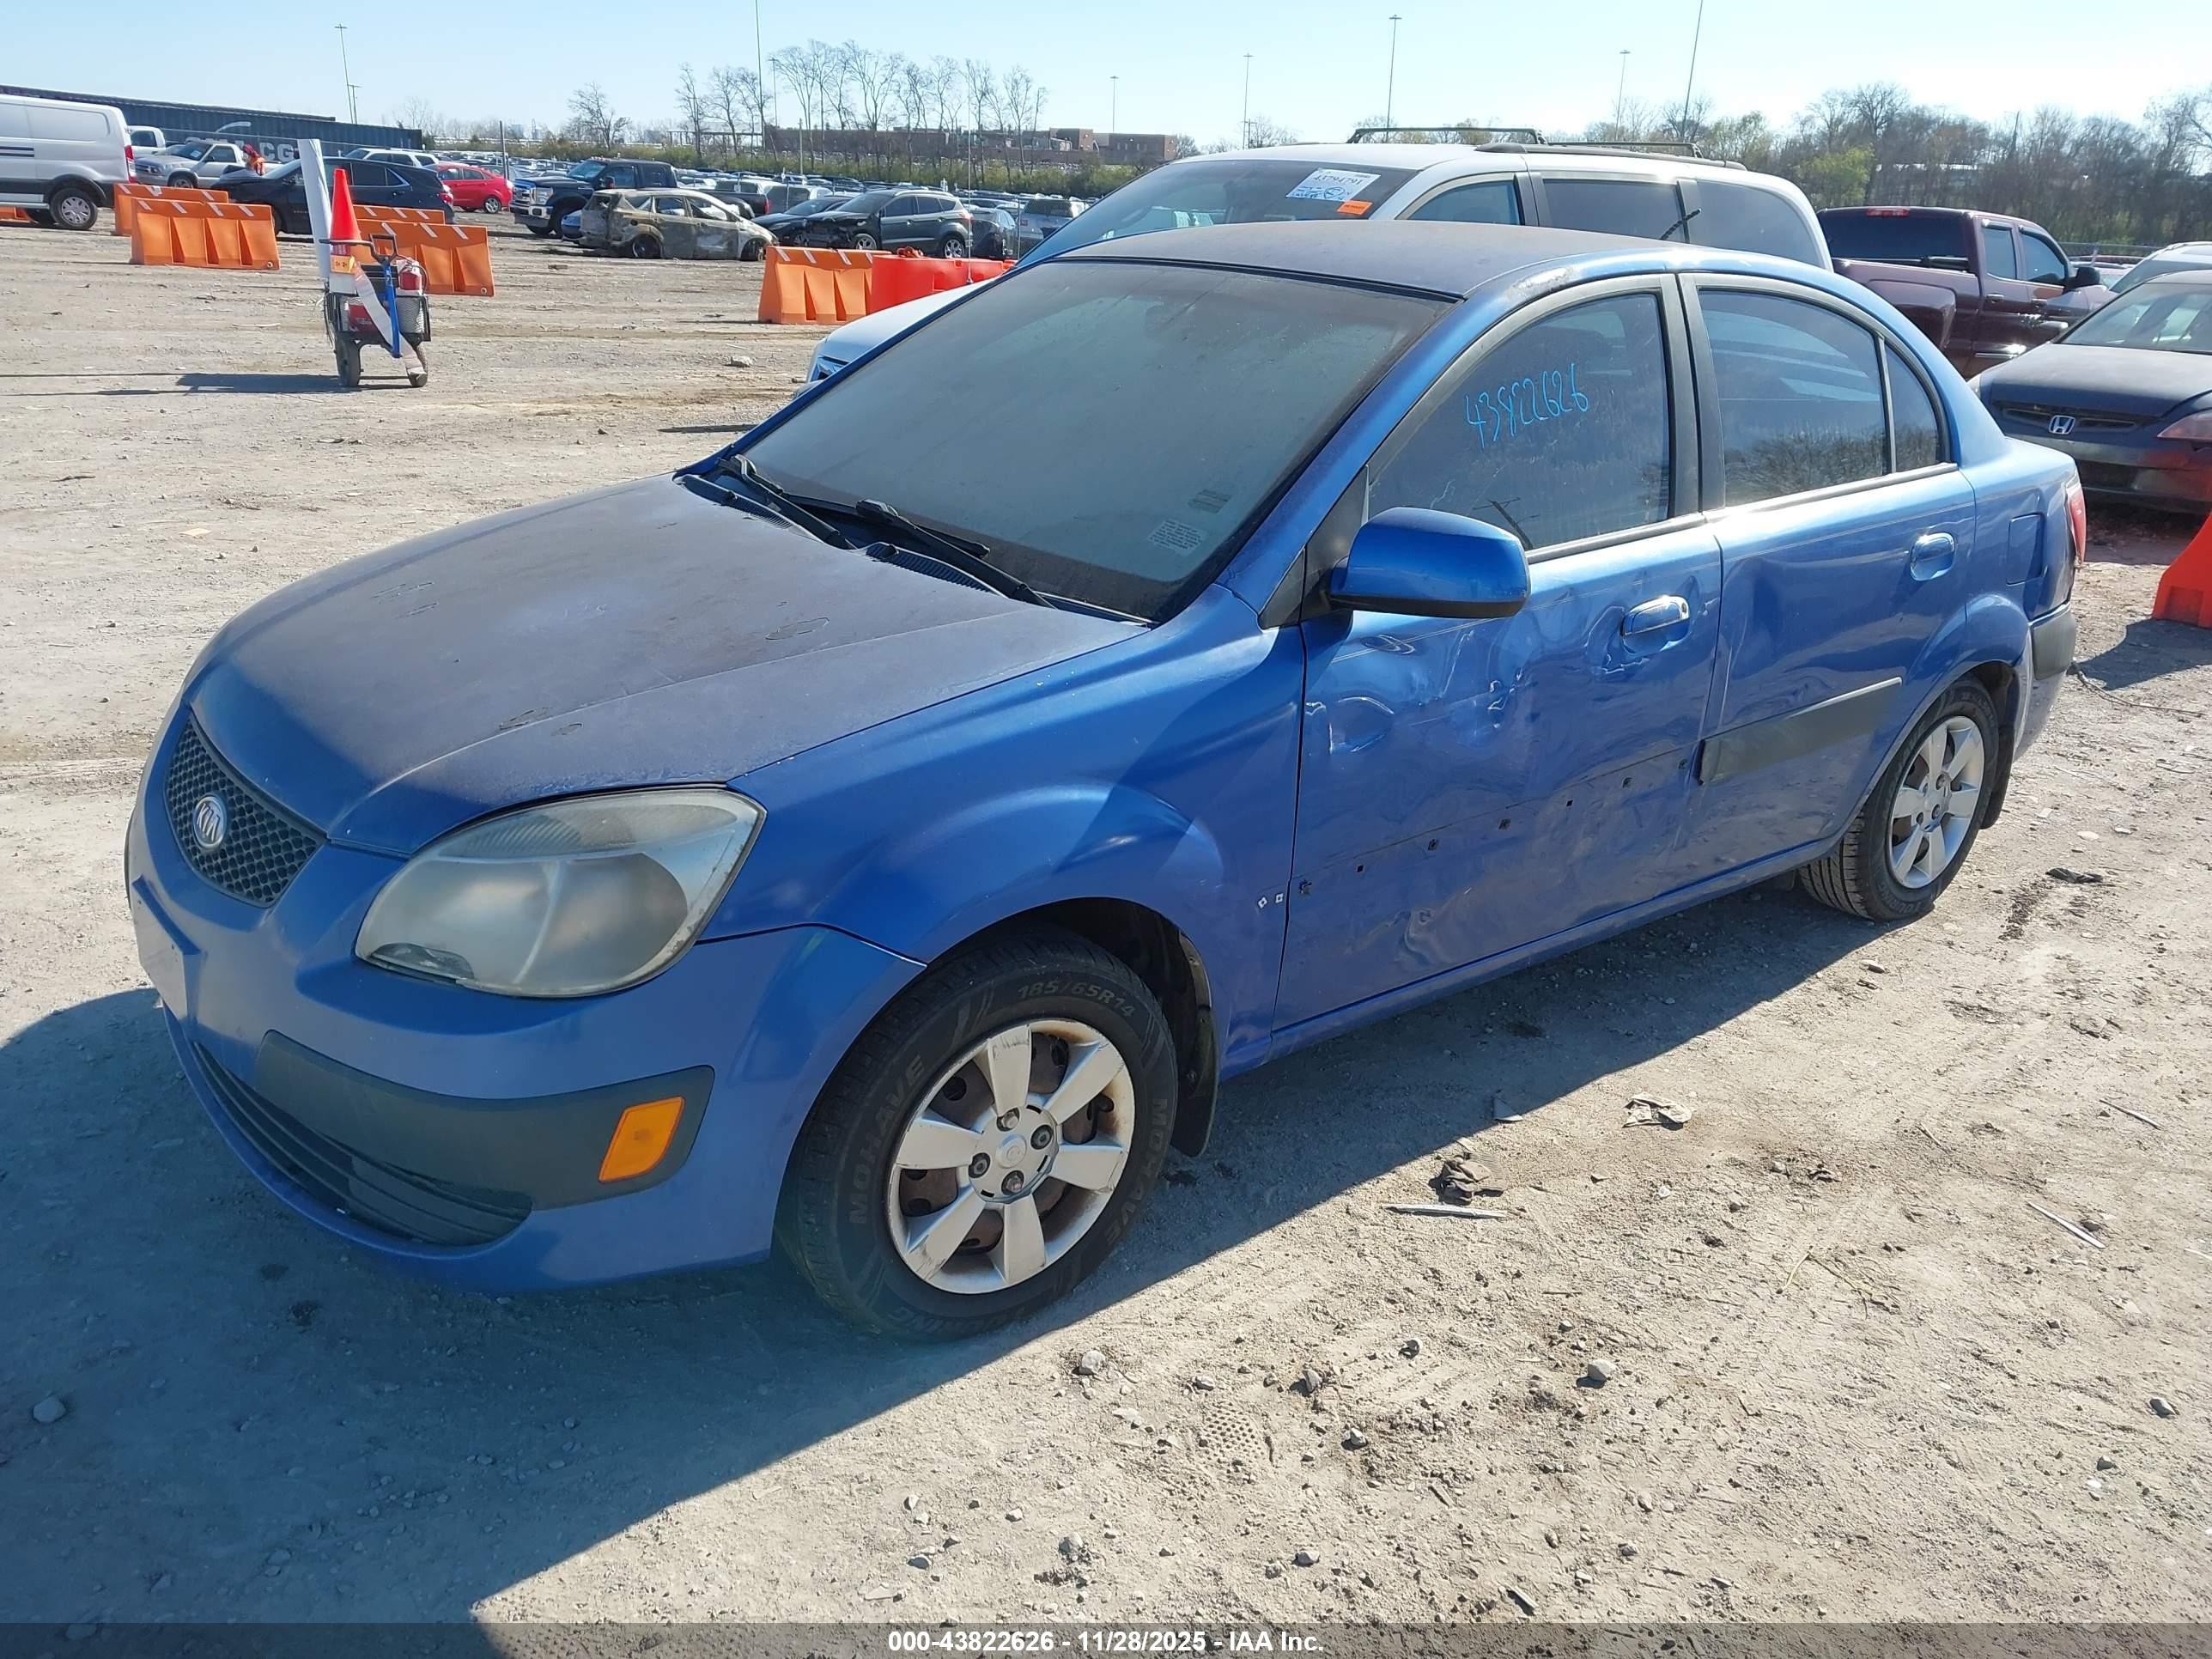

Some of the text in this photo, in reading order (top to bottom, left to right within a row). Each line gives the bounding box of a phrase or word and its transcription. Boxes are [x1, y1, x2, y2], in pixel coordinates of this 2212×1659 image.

[260, 142, 295, 163] CG
[1464, 362, 1589, 449] 43822626
[1019, 981, 1135, 1017] 185/65R14
[849, 1054, 927, 1225] MOHAVE
[1105, 1098, 1169, 1246] MOHAVE
